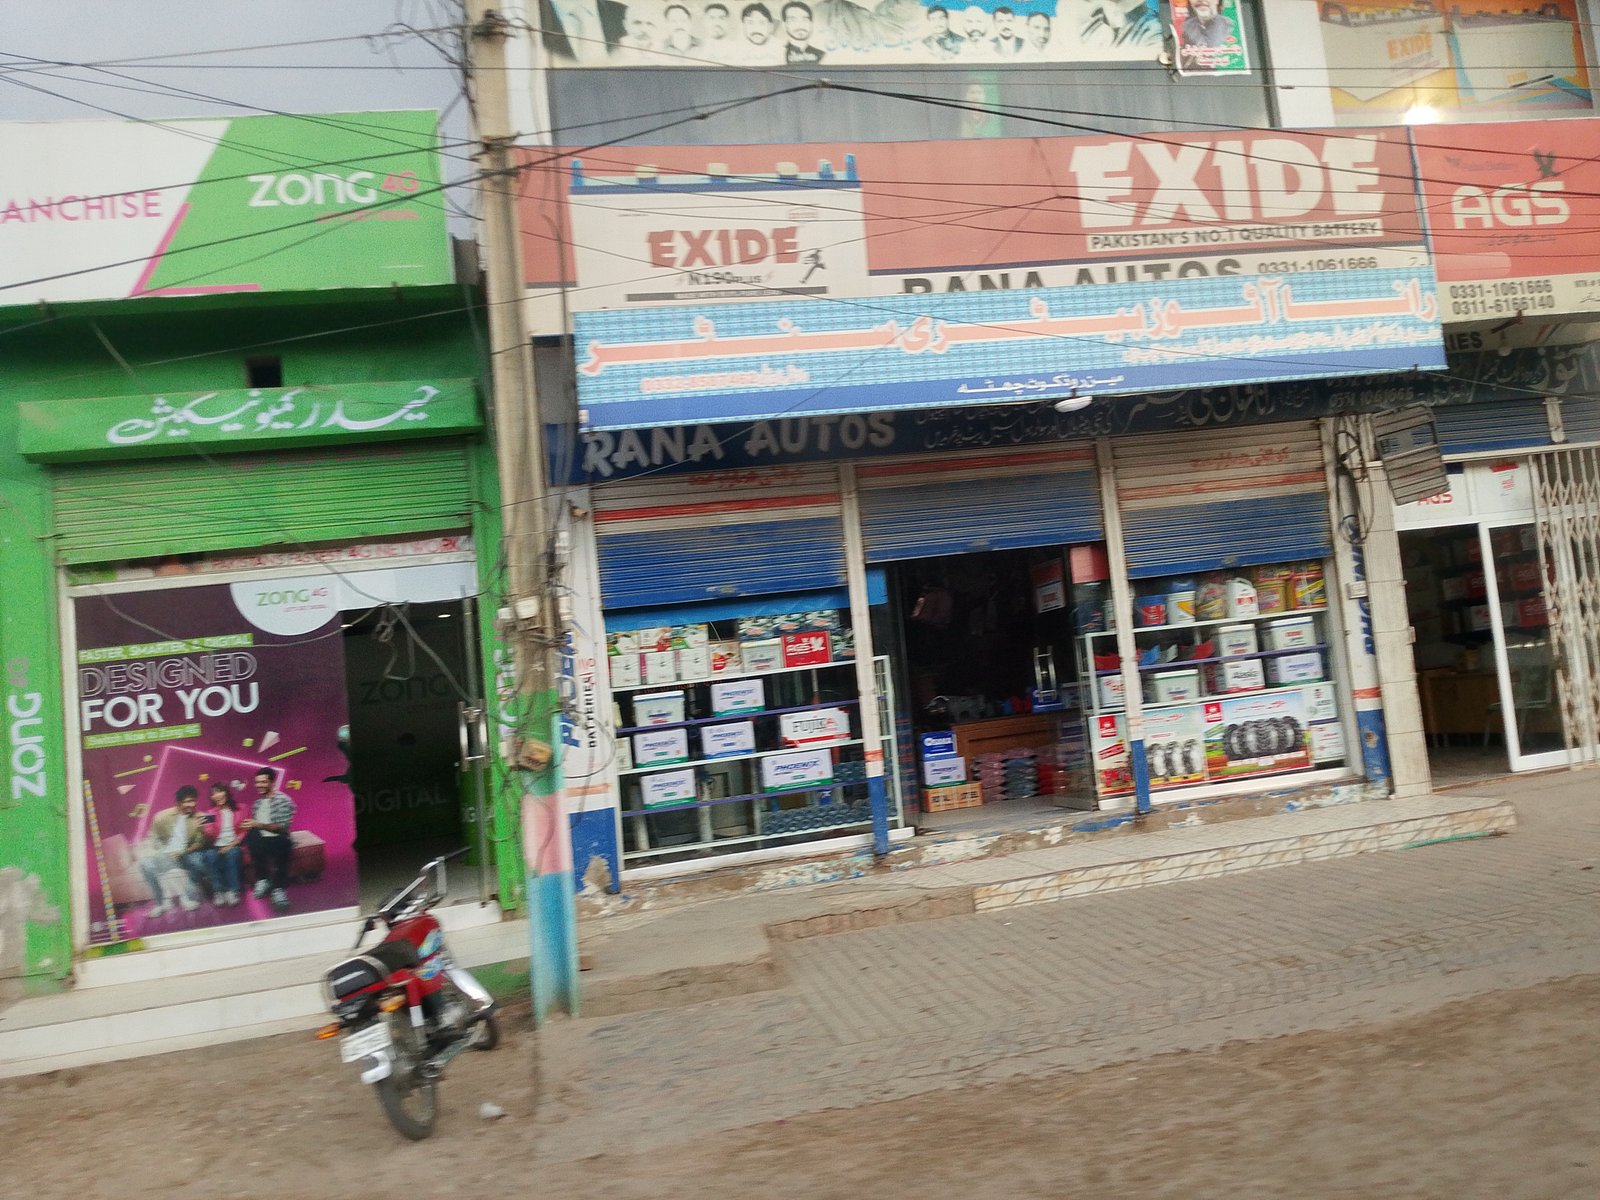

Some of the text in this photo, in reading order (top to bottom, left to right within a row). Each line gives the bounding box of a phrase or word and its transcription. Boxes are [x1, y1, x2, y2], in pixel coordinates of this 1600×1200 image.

[1069, 134, 1386, 228] EXIDE
[1452, 180, 1571, 229] AGS
[645, 226, 798, 268] EXIDE
[1091, 221, 1380, 251] PAKISTAN'S NO.1 QUALITY BATTERY
[581, 425, 725, 477] RANA
[745, 411, 896, 456] AUTOS
[78, 652, 258, 698] DESIGNED
[81, 682, 261, 731] FOR YOU
